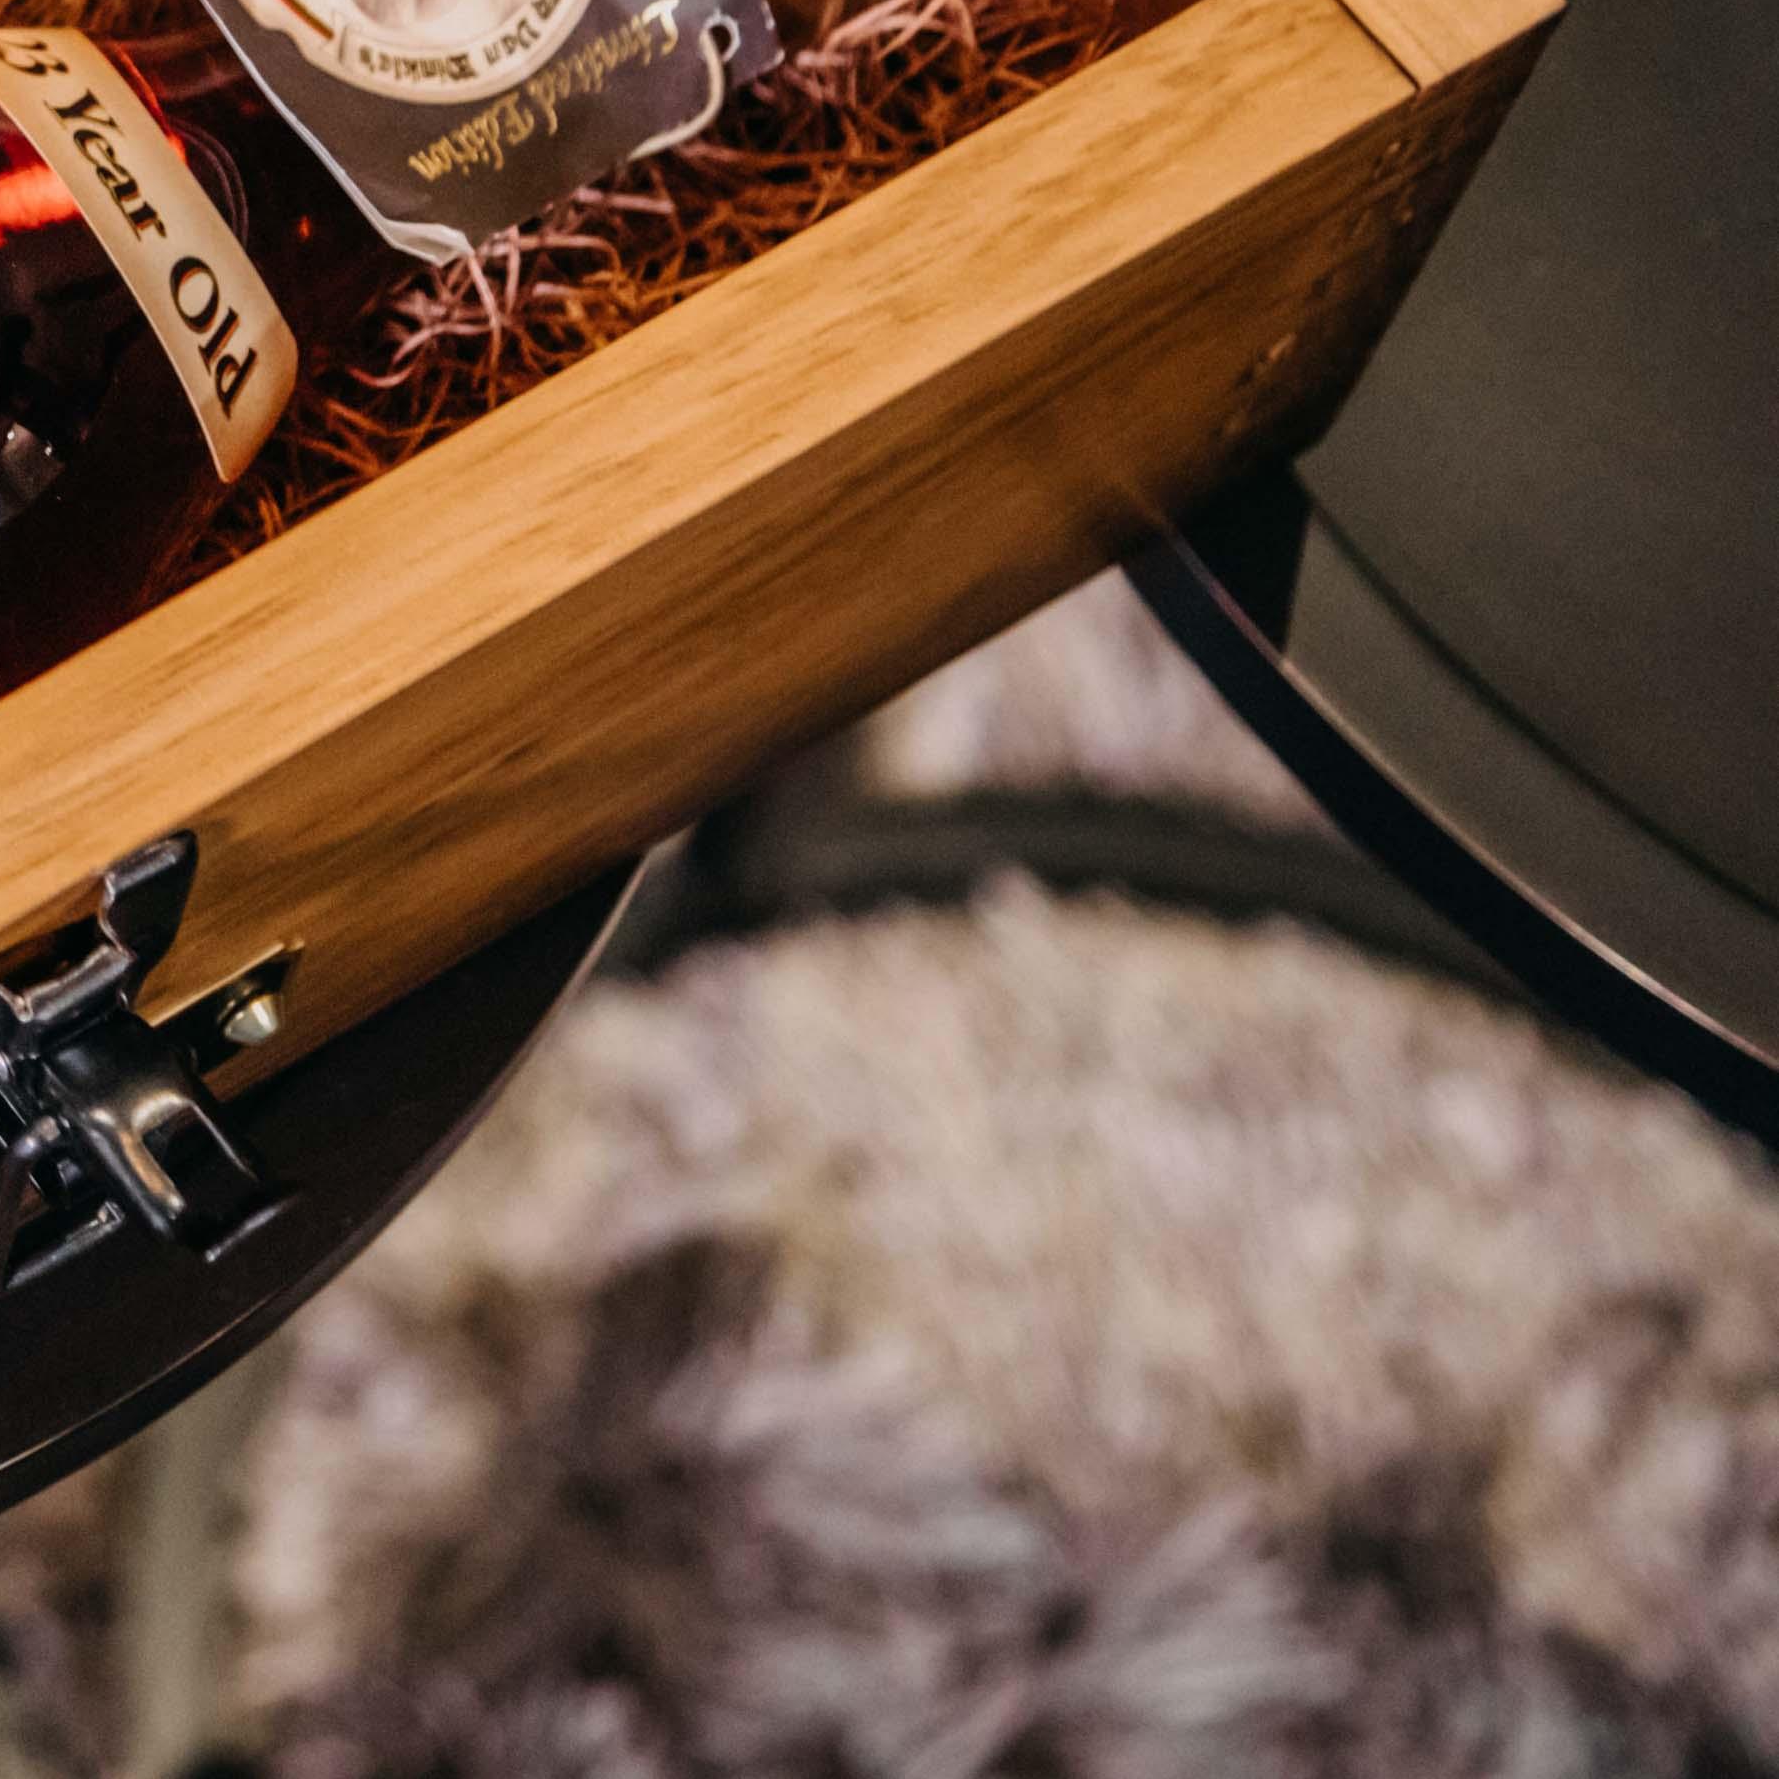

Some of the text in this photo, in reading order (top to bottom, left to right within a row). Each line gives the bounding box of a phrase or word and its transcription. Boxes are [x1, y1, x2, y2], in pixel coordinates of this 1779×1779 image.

[485, 15, 540, 65] Van
[407, 91, 535, 182] Edition
[44, 87, 168, 242] Year
[168, 255, 258, 420] Old
